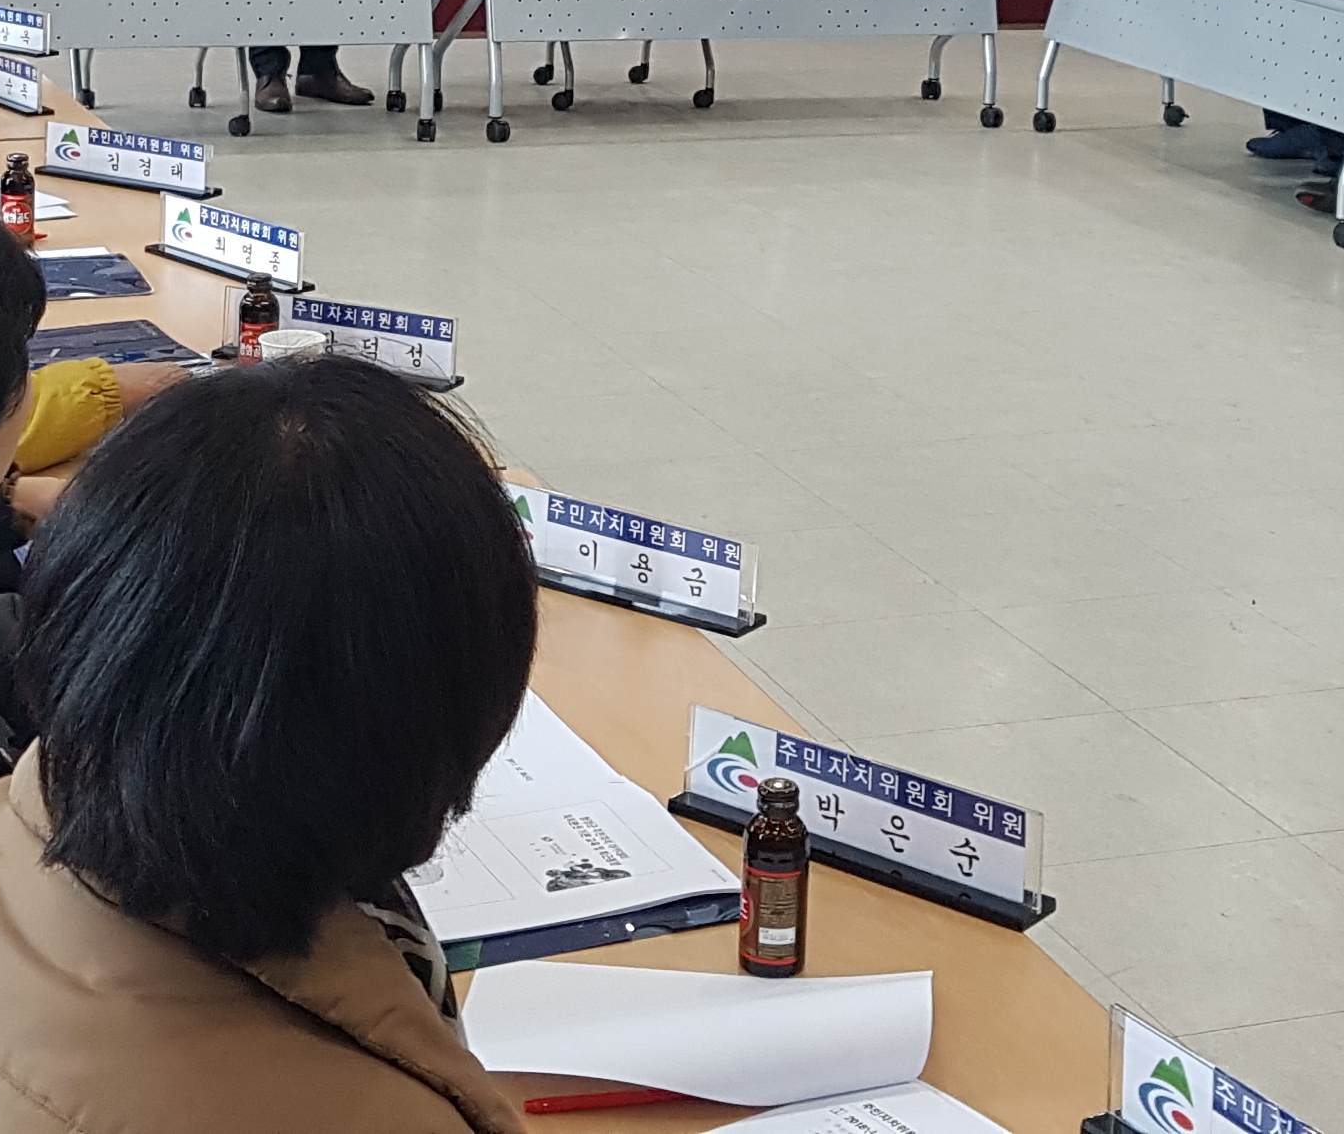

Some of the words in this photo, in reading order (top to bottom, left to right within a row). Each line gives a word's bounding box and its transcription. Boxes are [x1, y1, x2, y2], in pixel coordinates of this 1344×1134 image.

[89, 129, 172, 154] 주민자치위원회
[179, 143, 203, 159] 위원
[200, 207, 271, 241] 주민자치위원회
[278, 229, 298, 249] 위원
[293, 300, 408, 333] 주민자치위원회
[420, 317, 452, 339] 위원
[549, 498, 687, 552] 주민자치위원회
[701, 537, 741, 565] 위원
[777, 735, 954, 819] 주민자치위원회
[972, 800, 1024, 841] 위원
